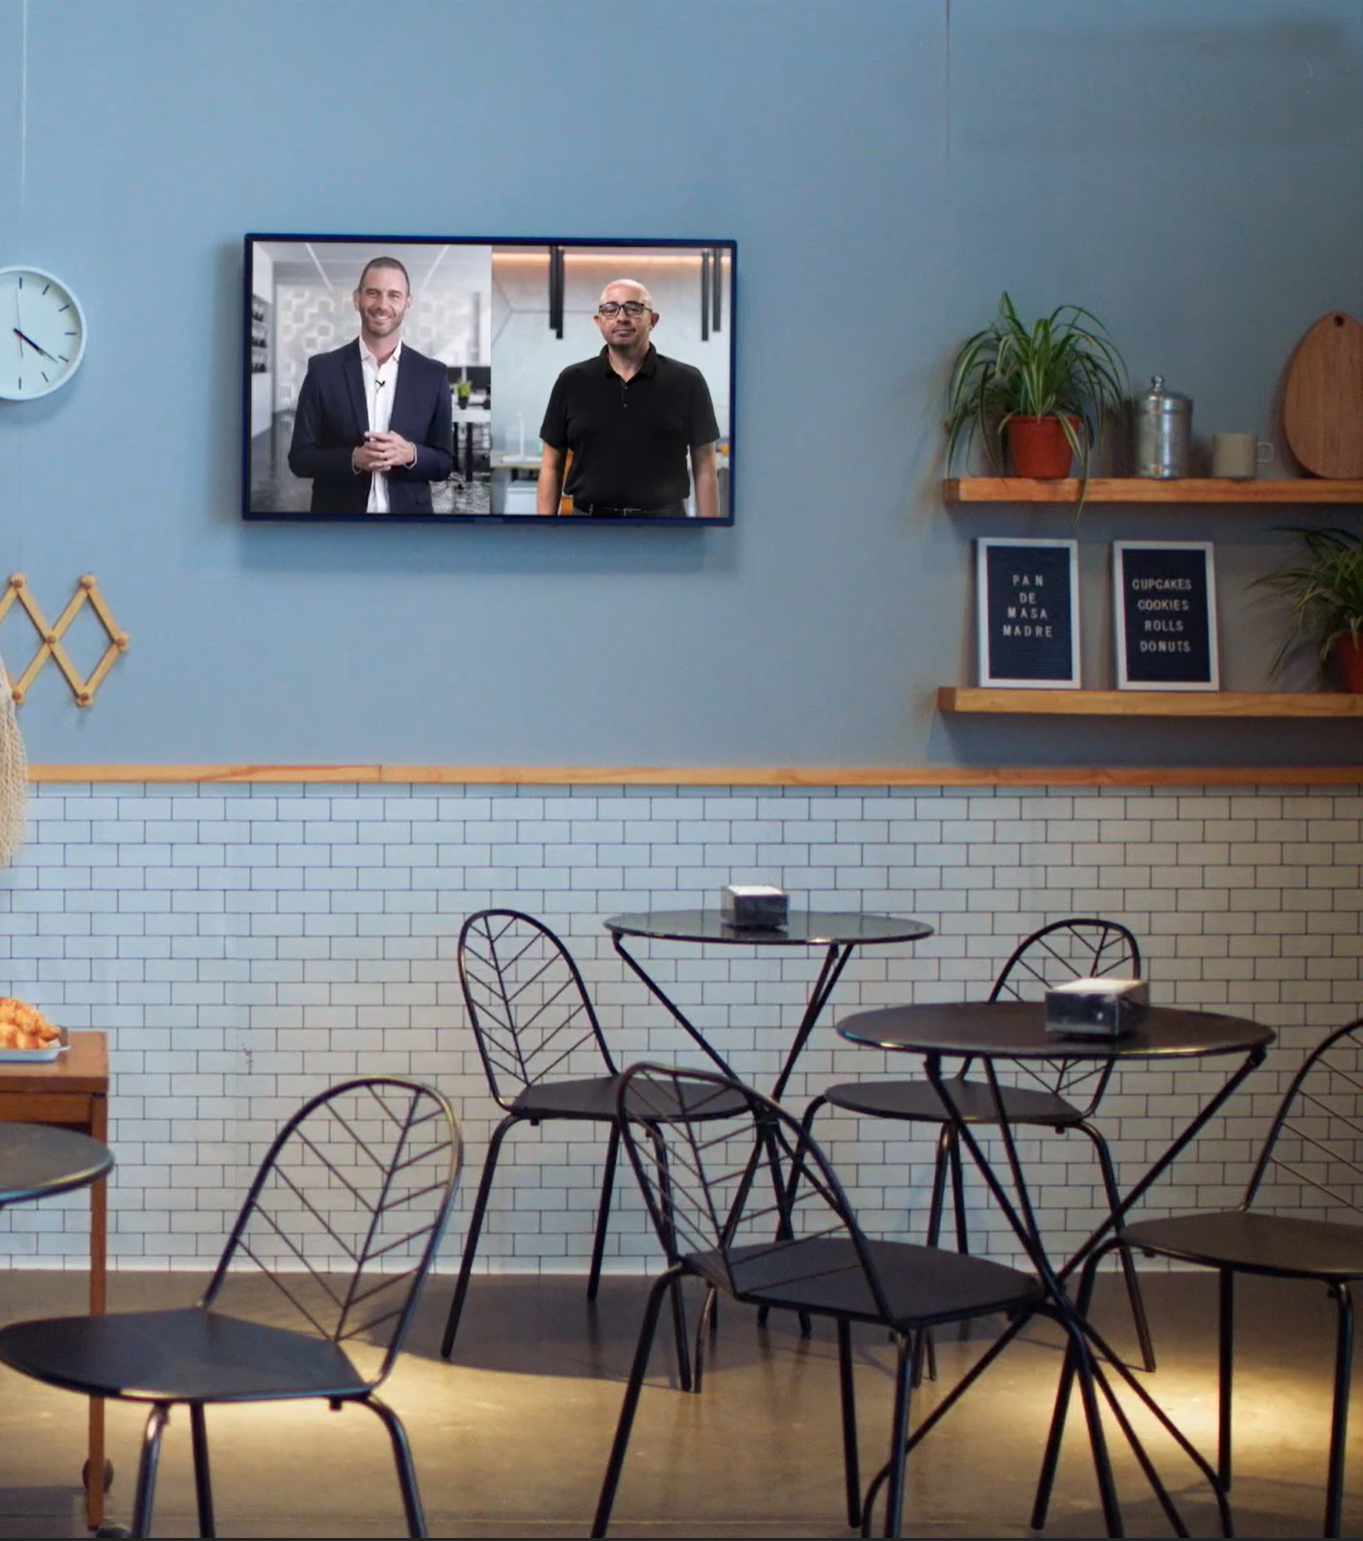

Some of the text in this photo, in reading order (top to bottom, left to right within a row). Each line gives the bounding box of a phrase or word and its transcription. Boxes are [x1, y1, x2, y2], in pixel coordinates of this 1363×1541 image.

[1012, 574, 1044, 587] PAN
[1132, 578, 1192, 590] CUPCAKES
[1019, 592, 1037, 605] DE
[1138, 599, 1189, 611] COOKIES
[1007, 606, 1048, 619] MASA
[1002, 624, 1053, 637] MADRE
[1144, 620, 1184, 632] ROLLS
[1140, 640, 1191, 653] DONUTS
